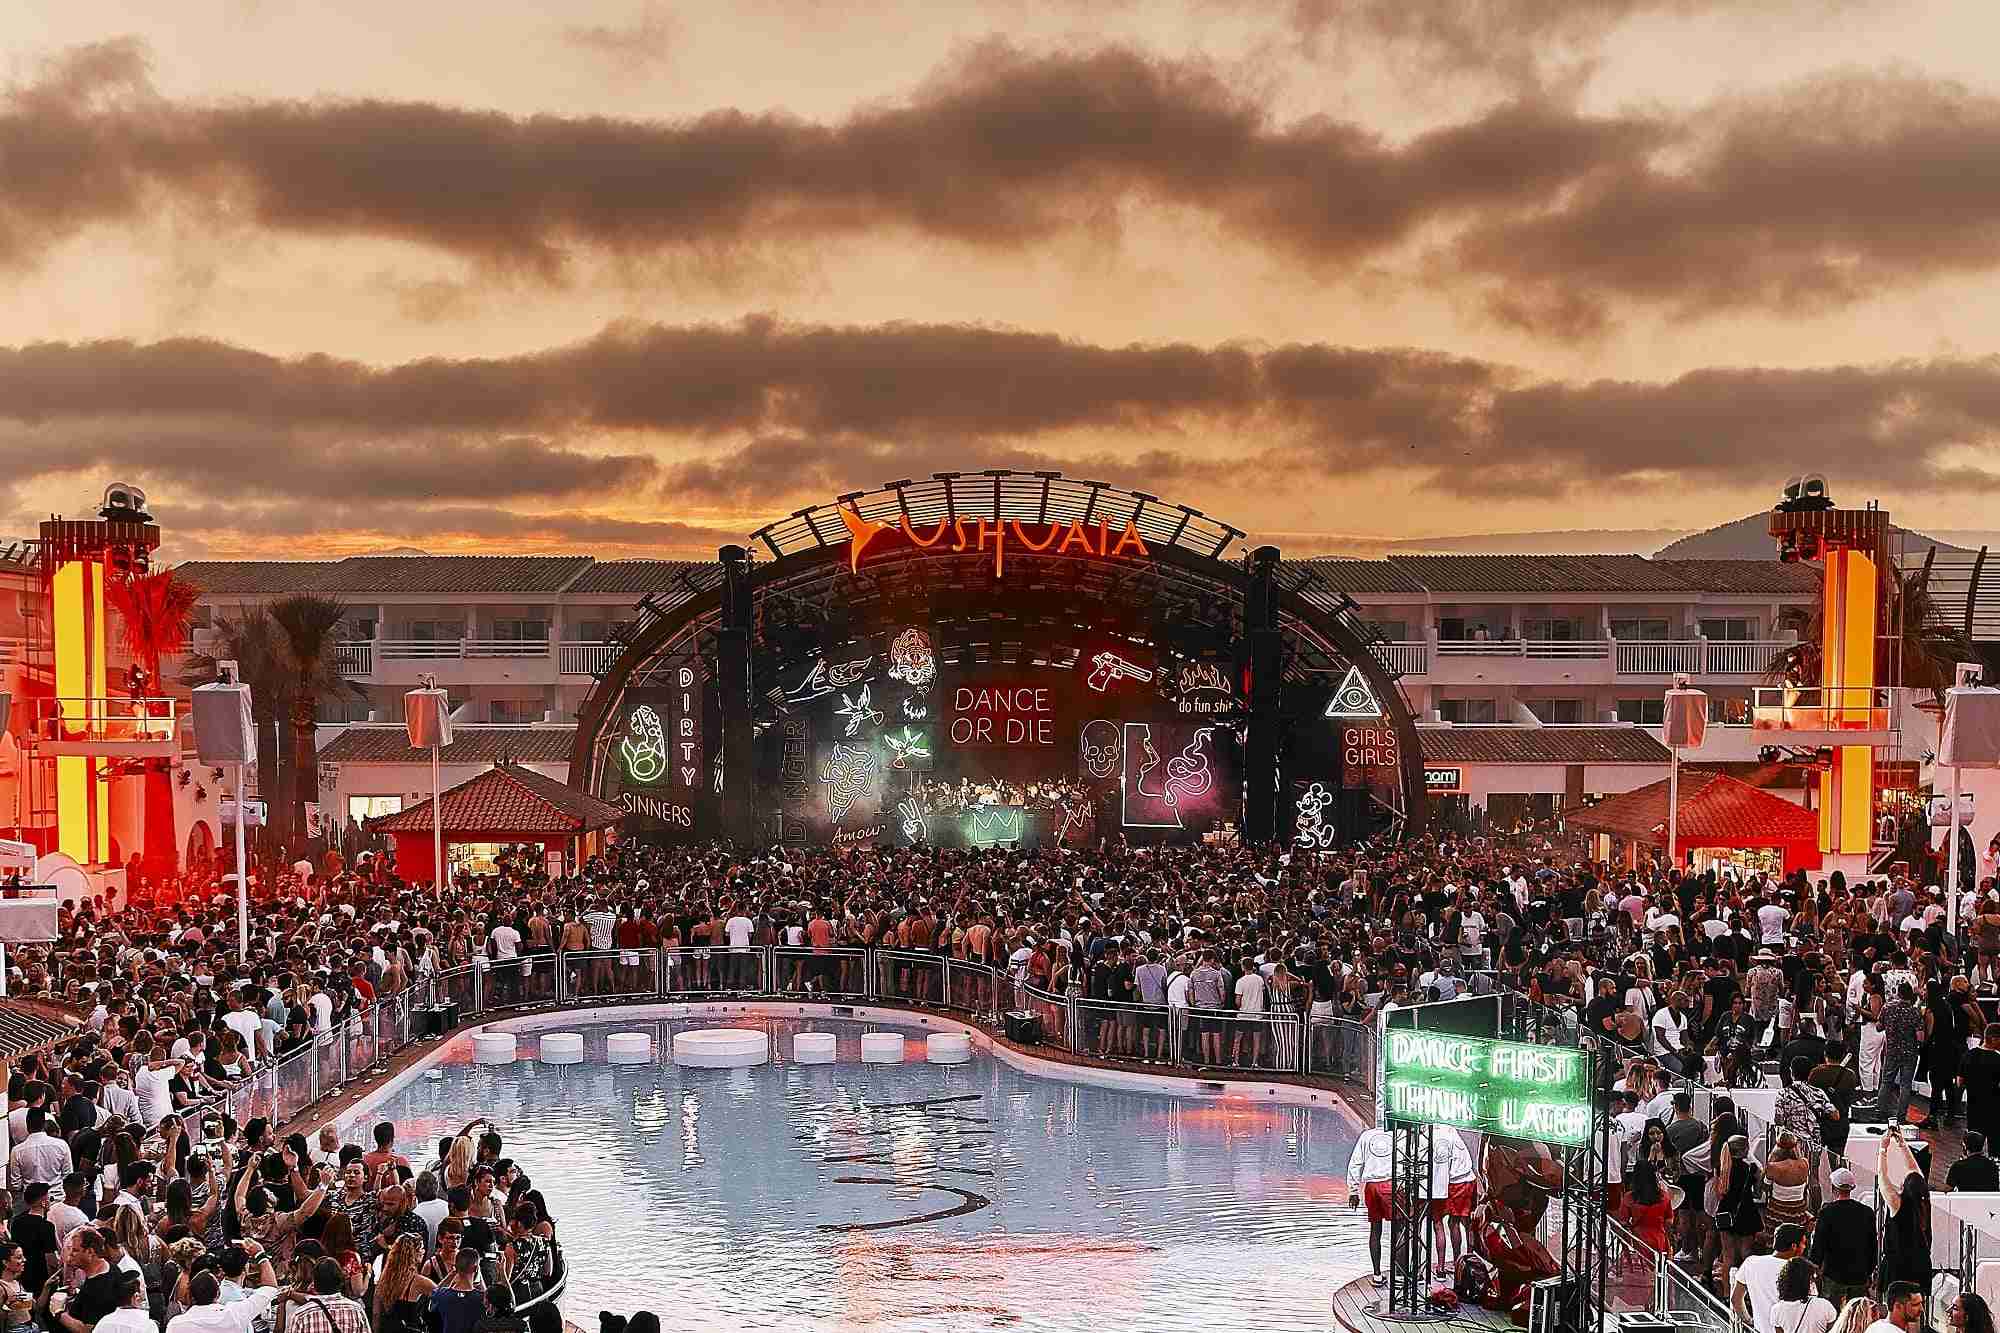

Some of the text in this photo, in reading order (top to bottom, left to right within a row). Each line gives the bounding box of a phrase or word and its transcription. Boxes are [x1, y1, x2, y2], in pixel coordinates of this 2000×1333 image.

[955, 688, 1050, 712] DANCE
[1179, 697, 1191, 713] do
[1194, 697, 1210, 713] fun
[679, 668, 696, 786] DIRTY
[951, 717, 1054, 744] OR DIE
[1345, 729, 1395, 746] GIRLS
[1345, 748, 1396, 765] GIRLS
[622, 792, 692, 827] SINNERS
[1392, 1034, 1570, 1083] DANCE FIRST
[1391, 1082, 1479, 1121] THINK
